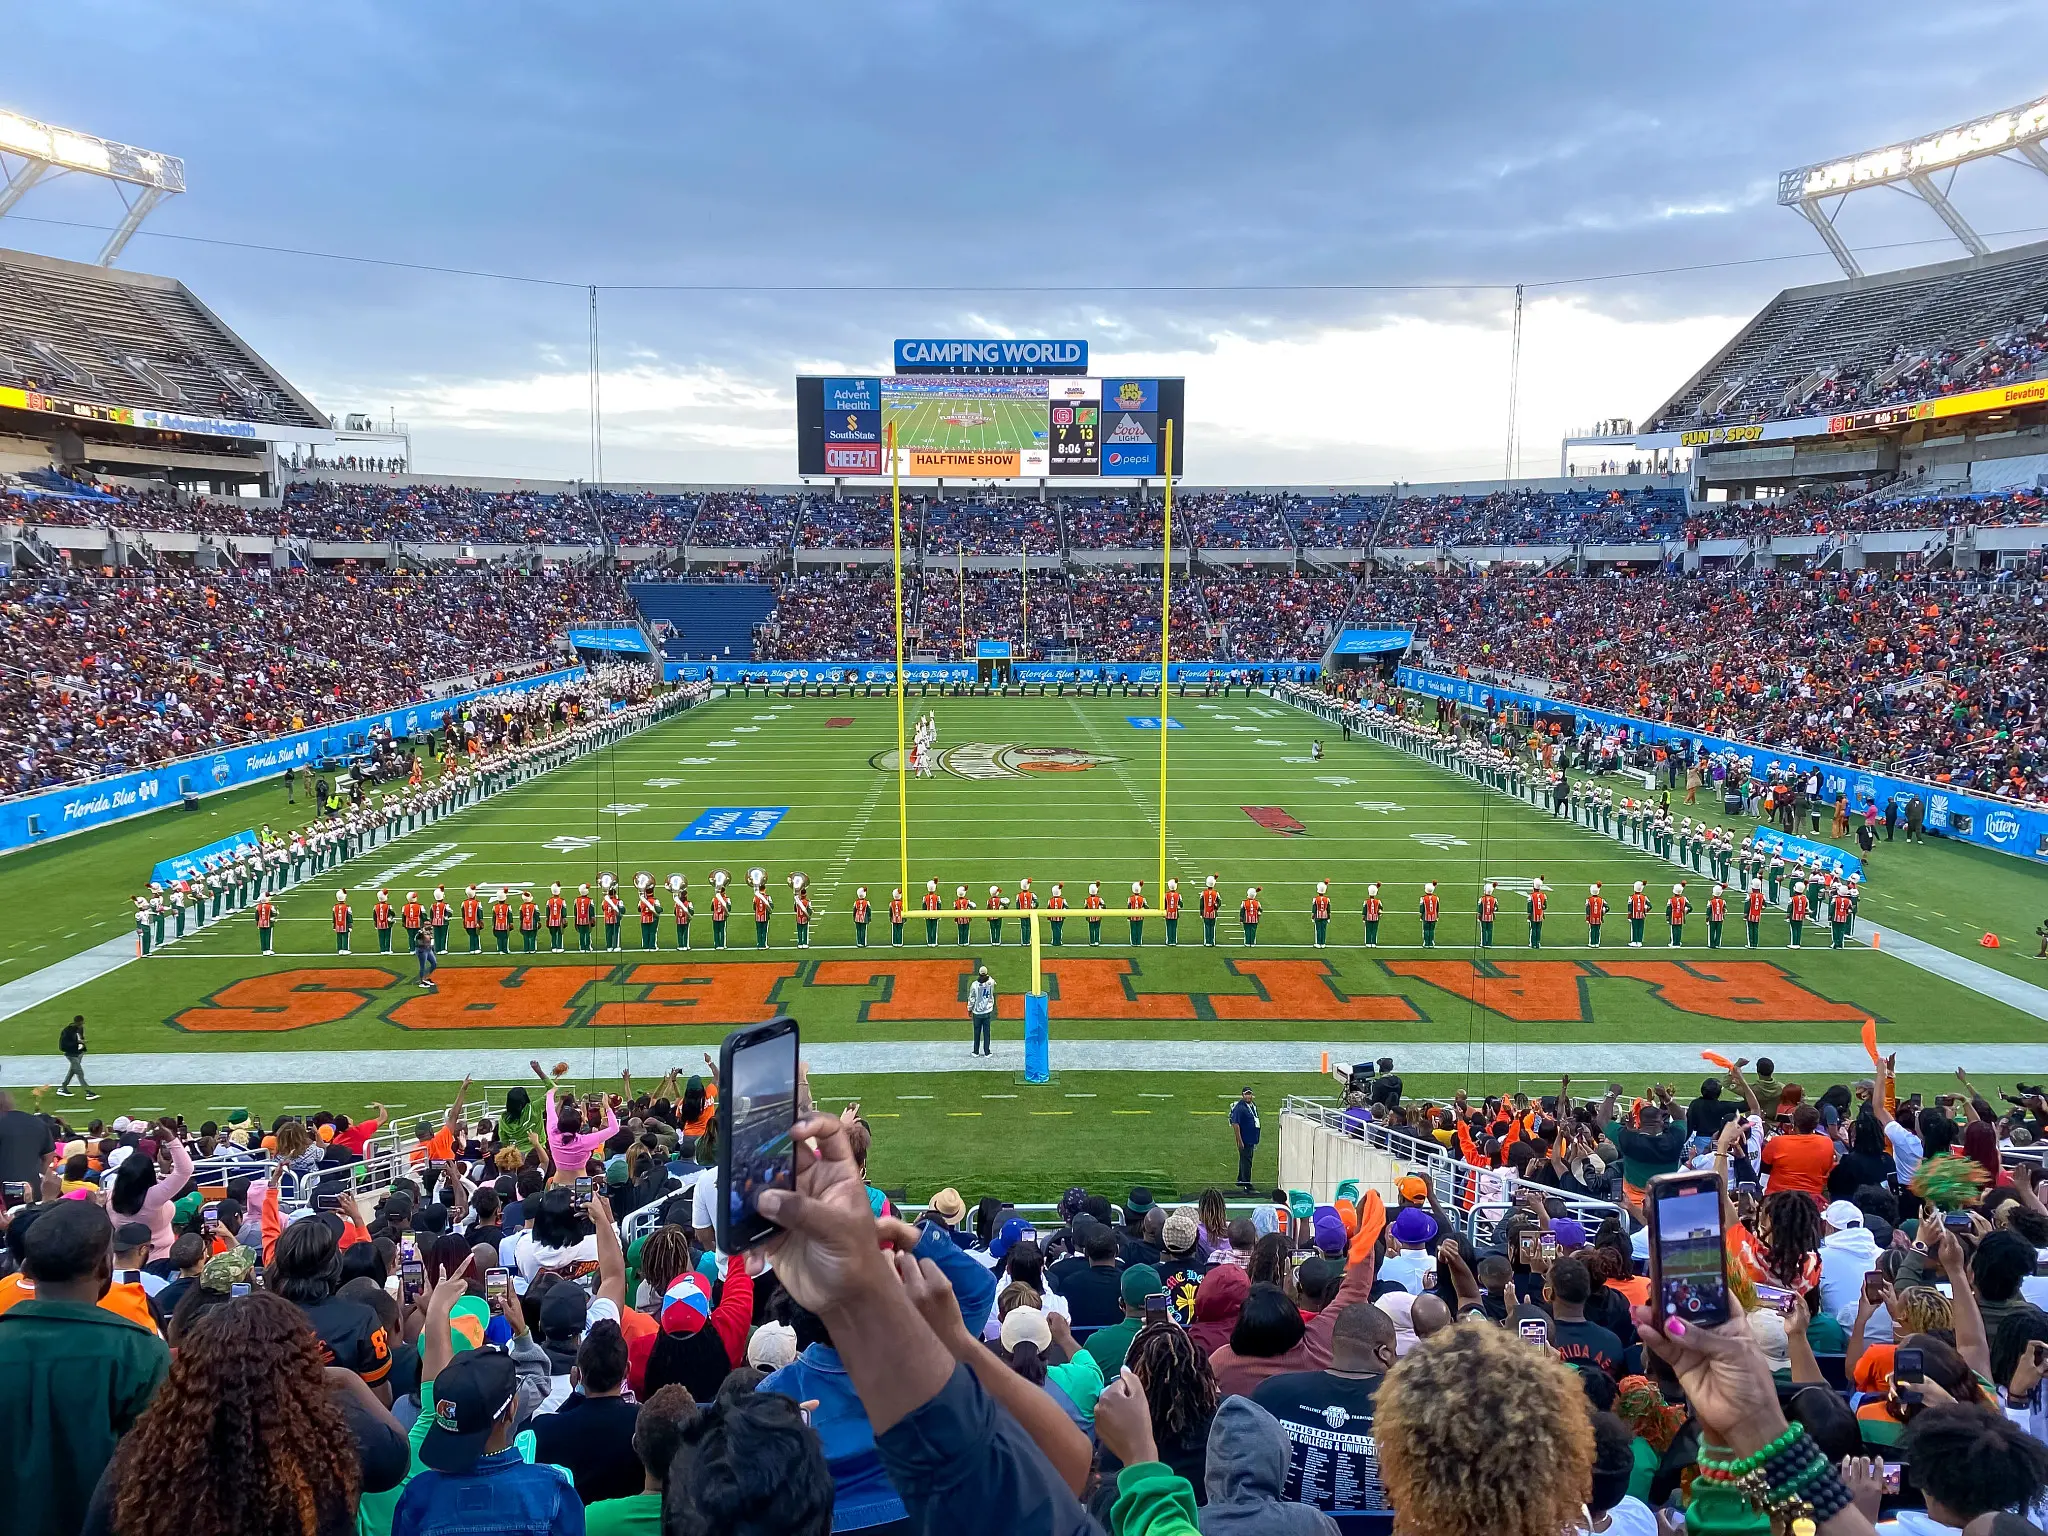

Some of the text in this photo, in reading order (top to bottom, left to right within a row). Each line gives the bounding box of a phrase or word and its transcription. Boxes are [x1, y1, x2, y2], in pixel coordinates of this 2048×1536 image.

[902, 343, 1080, 362] CAMPING WORLD
[950, 366, 1033, 374] STADIUM
[834, 390, 870, 400] Advent
[2005, 386, 2045, 401] Elevating
[837, 401, 870, 410] Health
[829, 430, 876, 440] SouthState
[1059, 429, 1066, 439] 7
[1080, 429, 1093, 439] 13
[1114, 423, 1145, 436] Coors
[1681, 431, 1710, 446] FUN
[1726, 426, 1763, 441] SPOT
[1058, 444, 1081, 454] 8:06
[917, 455, 1013, 465] HALFTIME SHOW
[1123, 455, 1149, 465] pepsi
[246, 754, 277, 773] Florida
[278, 748, 294, 763] Blue
[64, 788, 136, 822] Florida Blue
[695, 811, 742, 836] Florida
[1984, 813, 2020, 840] Lottery
[165, 957, 1893, 1033] RATTLERS
[1560, 1343, 1590, 1361] RIDA
[1295, 1425, 1372, 1444] HISTORICALLY
[1287, 1431, 1377, 1456] ACK COLLEGES & UNIVERSI
